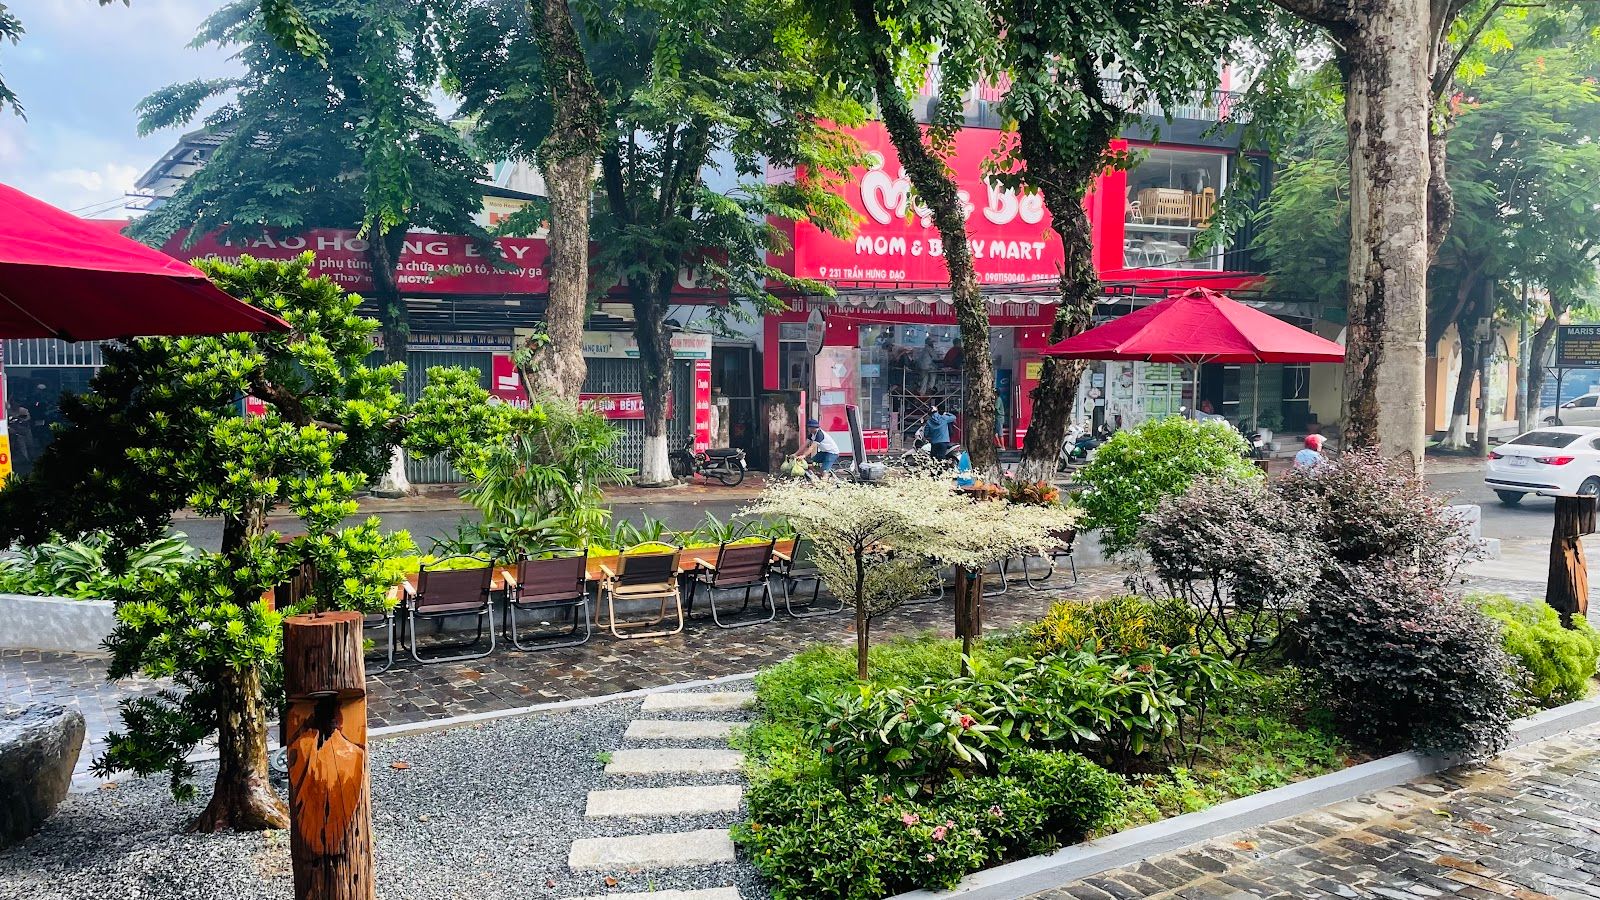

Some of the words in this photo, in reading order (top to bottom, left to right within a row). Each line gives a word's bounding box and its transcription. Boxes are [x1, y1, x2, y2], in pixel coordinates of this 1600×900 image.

[222, 229, 306, 250] ẢO
[317, 236, 449, 256] HONG
[855, 235, 906, 256] MOM
[911, 240, 923, 256] &
[928, 238, 985, 260] BY
[989, 240, 1046, 261] MART
[333, 272, 361, 283] Thay
[529, 267, 543, 279] ga
[828, 268, 841, 278] 231
[889, 270, 906, 281] ĐẠO
[1567, 327, 1594, 335] MARIS
